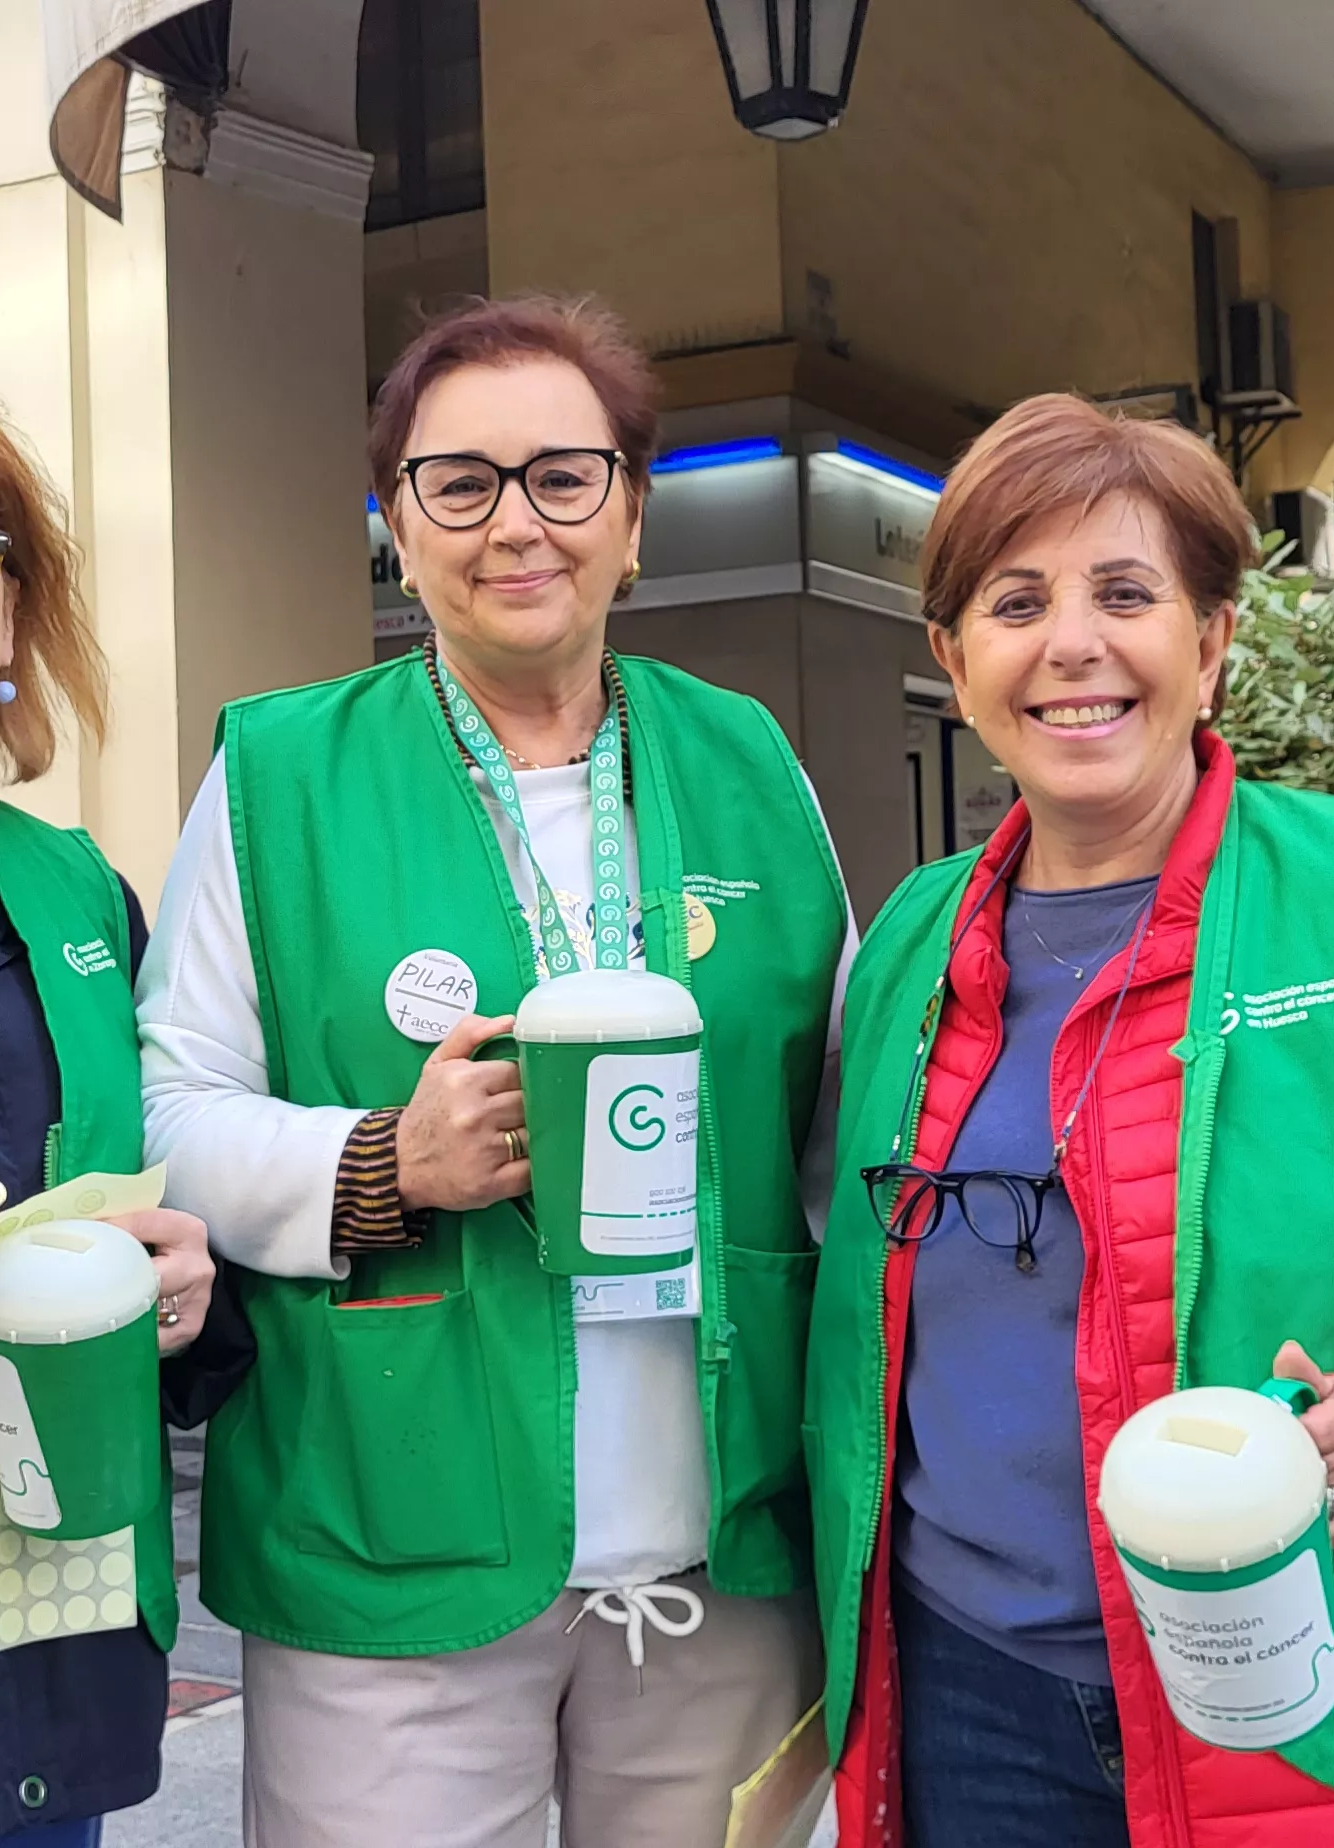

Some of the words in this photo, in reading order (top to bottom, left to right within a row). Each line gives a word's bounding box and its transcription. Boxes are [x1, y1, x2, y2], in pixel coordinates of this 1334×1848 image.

[397, 962, 474, 1000] PILAR
[410, 1016, 449, 1034] aecc
[1159, 1611, 1265, 1634] asociación
[1168, 1643, 1229, 1666] contra
[1233, 1651, 1253, 1665] el
[1256, 1620, 1315, 1661] cáncer
